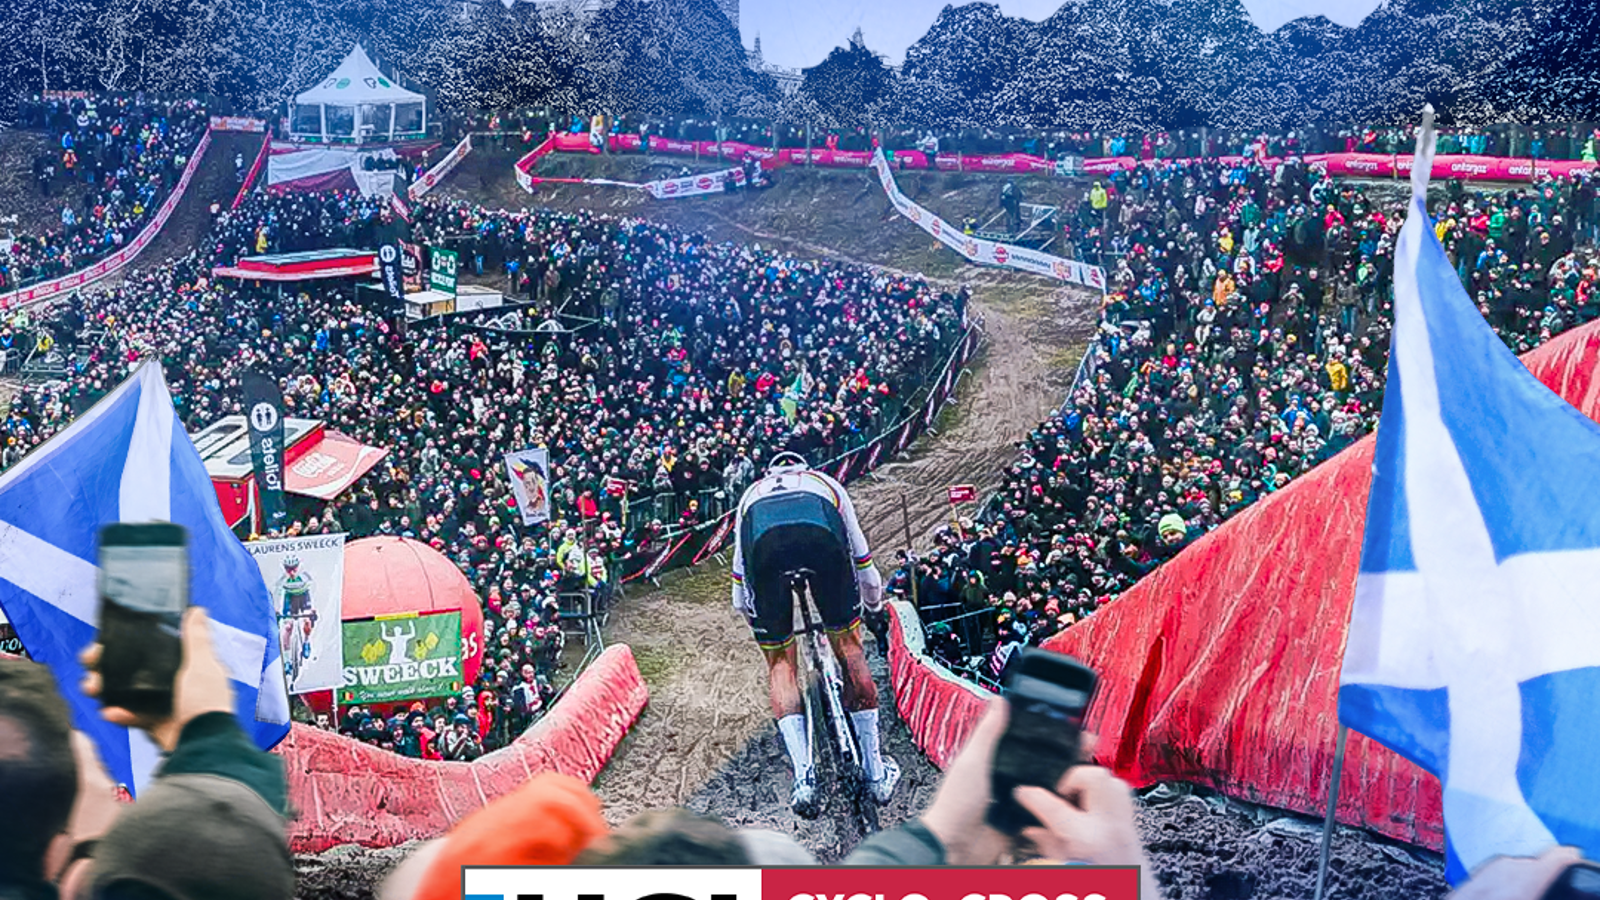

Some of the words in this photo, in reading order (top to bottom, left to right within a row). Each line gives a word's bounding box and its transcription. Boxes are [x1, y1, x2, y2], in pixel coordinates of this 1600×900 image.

[248, 543, 296, 555] LAURENS
[297, 539, 339, 551] SWEECK
[343, 656, 459, 687] SWEECK
